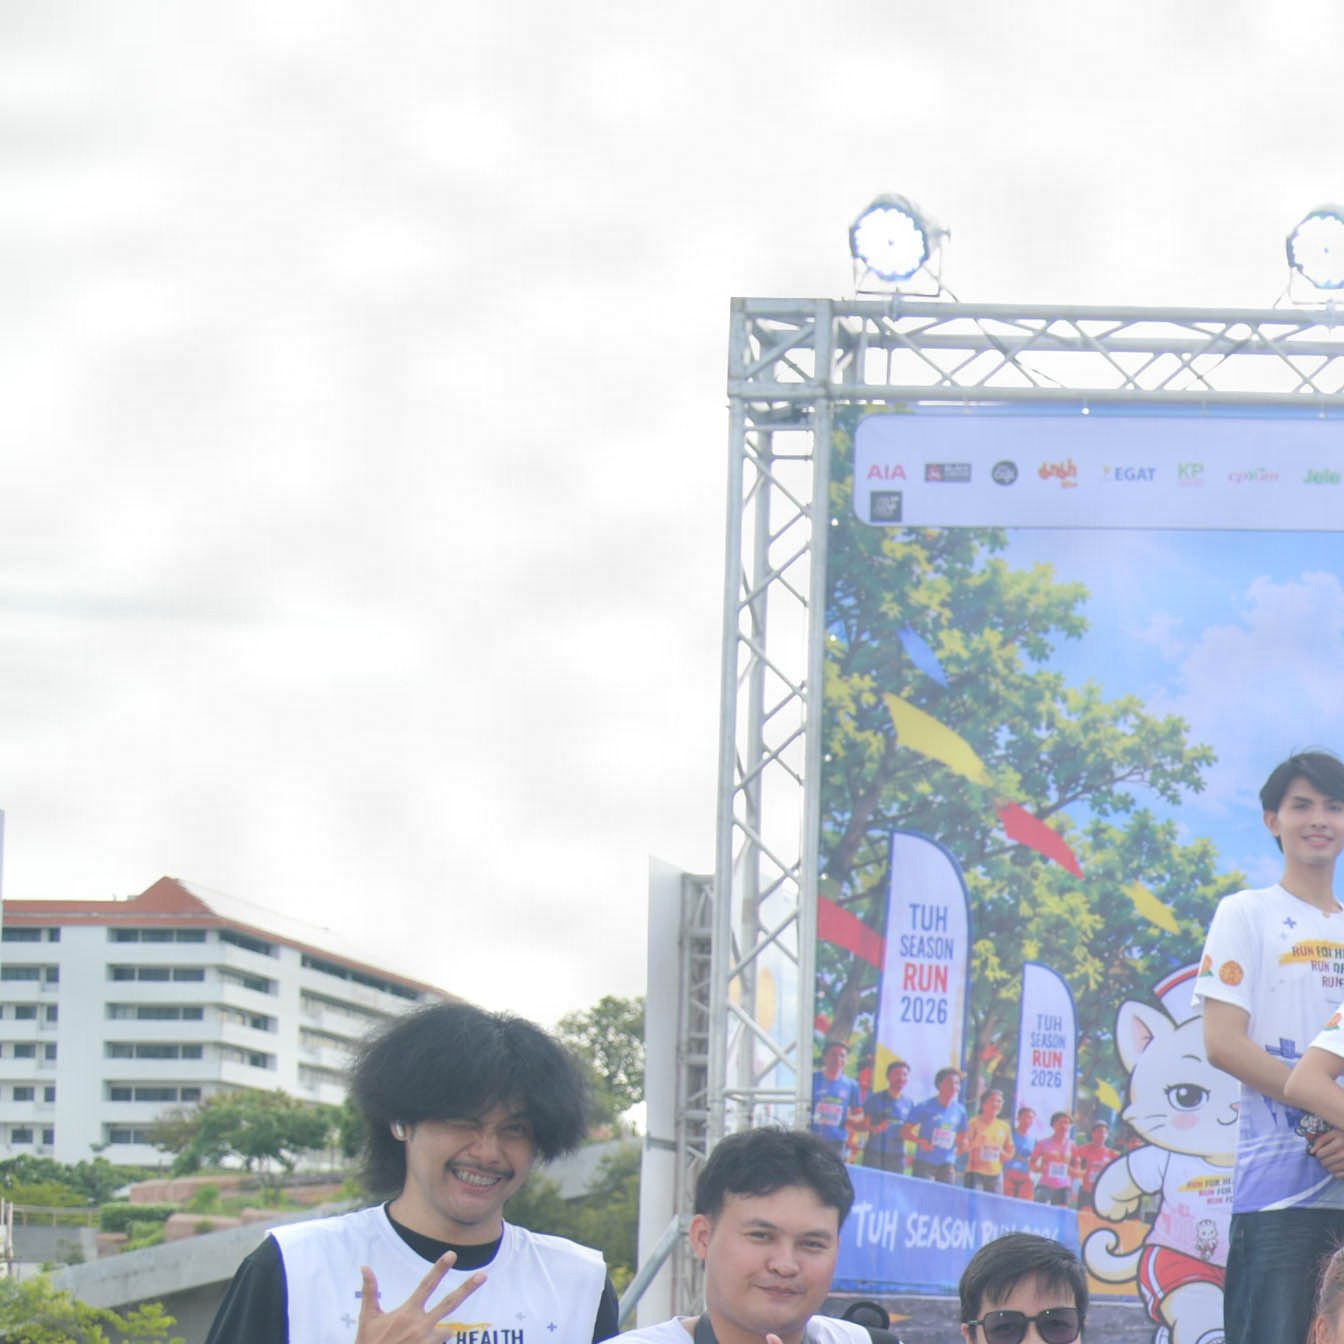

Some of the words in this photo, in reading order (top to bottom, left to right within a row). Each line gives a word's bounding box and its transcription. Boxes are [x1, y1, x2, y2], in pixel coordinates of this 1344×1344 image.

[867, 464, 907, 481] AIA
[1114, 466, 1157, 482] EGAT
[909, 903, 948, 931] TUH
[900, 934, 954, 960] SEASON
[902, 962, 948, 993] RUN
[900, 996, 948, 1025] 2026
[1036, 1014, 1063, 1031] TUH
[1029, 1032, 1066, 1049] SEASON
[1032, 1049, 1063, 1068] RUN
[1030, 1069, 1062, 1088] 2026
[852, 1202, 899, 1252] TUH
[904, 1211, 977, 1250] SEASON
